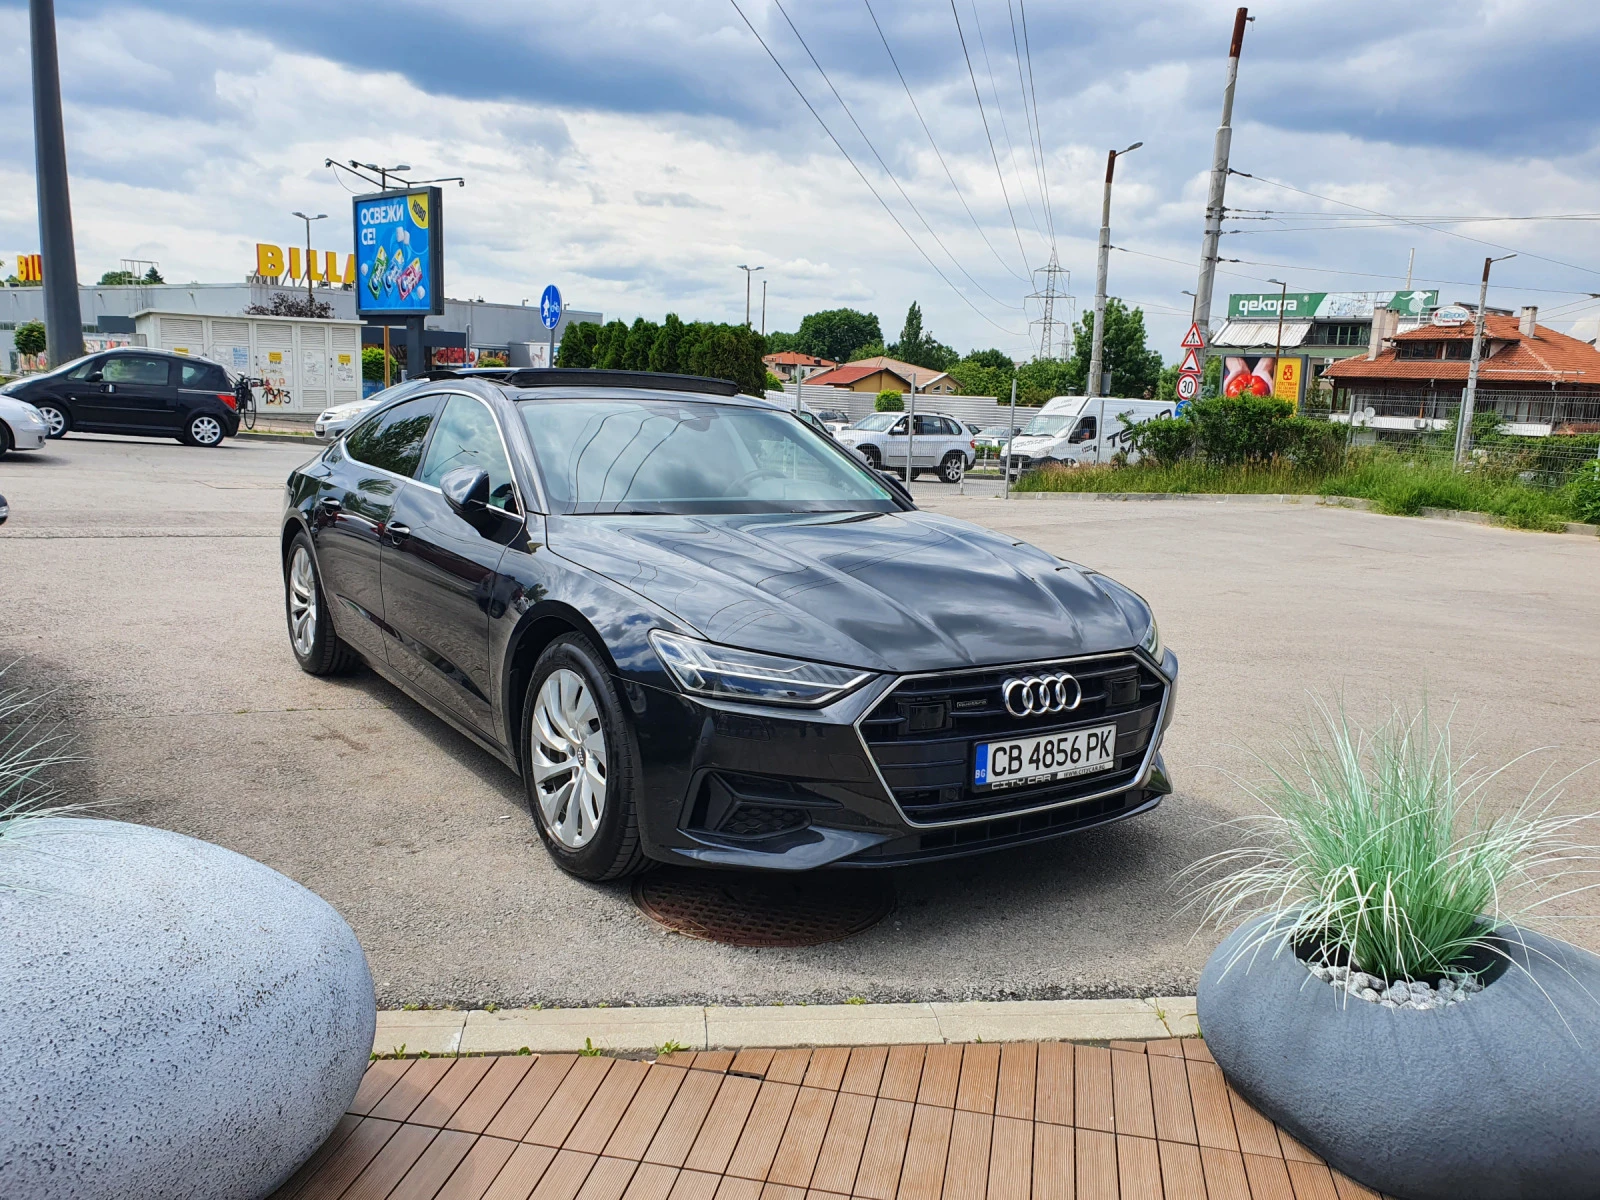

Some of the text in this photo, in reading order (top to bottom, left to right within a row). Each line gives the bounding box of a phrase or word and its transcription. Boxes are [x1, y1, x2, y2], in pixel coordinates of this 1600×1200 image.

[361, 204, 404, 225] ОСВЕЖИ
[361, 228, 376, 246] СЕ!
[17, 254, 42, 281] BIL
[1181, 380, 1193, 394] 30
[262, 388, 291, 404] 1913
[991, 729, 1113, 777] CB 4856 PK
[975, 769, 986, 779] BG
[991, 774, 1052, 790] CITY CAR
